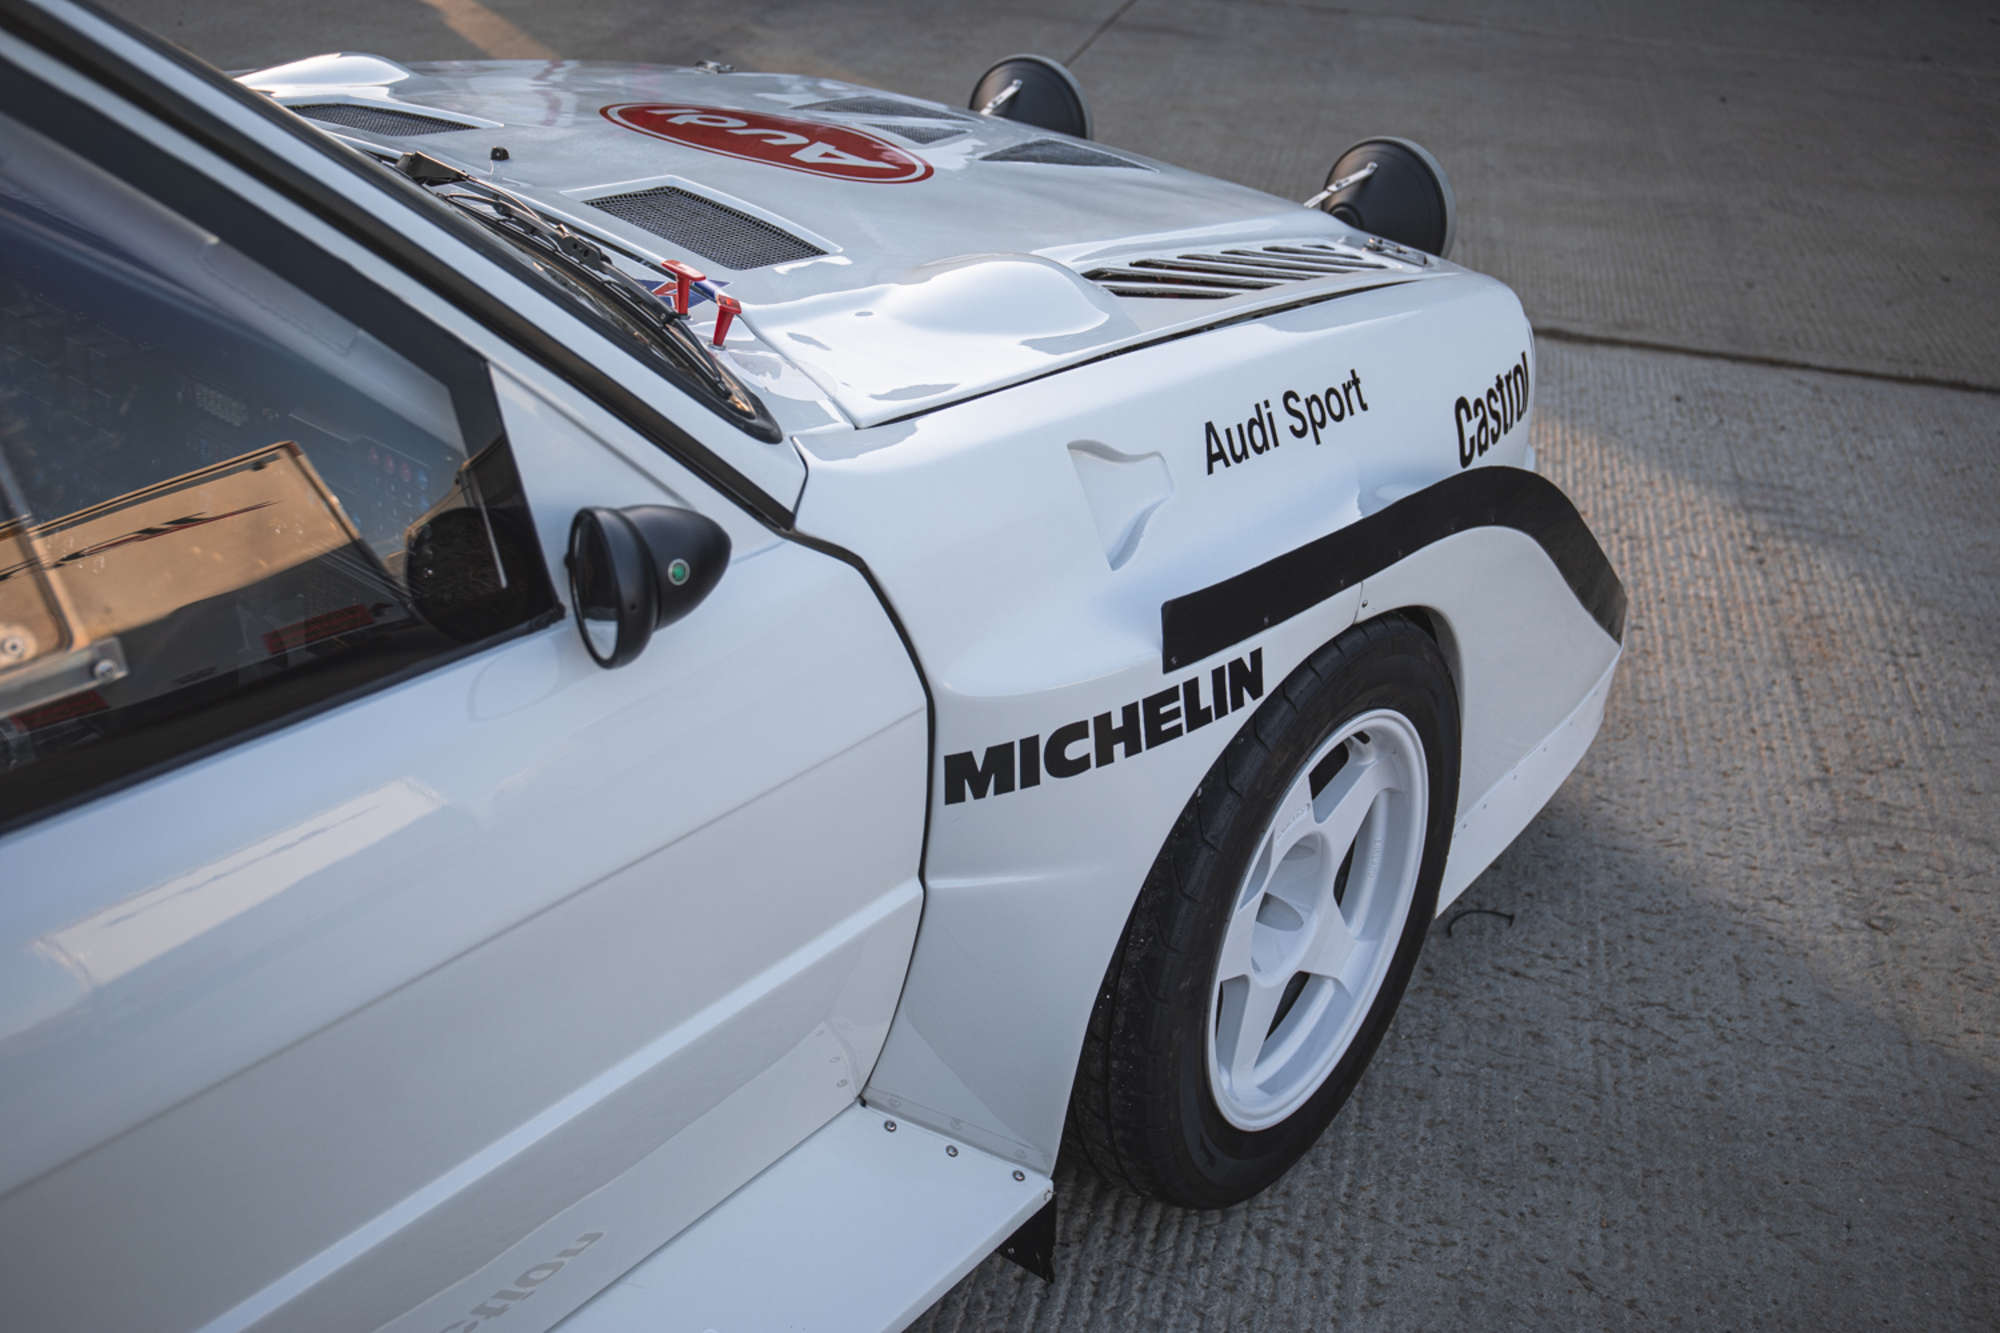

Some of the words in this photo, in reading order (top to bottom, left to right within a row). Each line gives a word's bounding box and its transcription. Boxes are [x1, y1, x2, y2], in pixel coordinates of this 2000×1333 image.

[646, 108, 902, 170] Audi
[1204, 399, 1280, 476] Audi
[1282, 368, 1369, 446] Sport
[1454, 350, 1530, 470] Castrol
[943, 646, 1264, 806] MICHELIN
